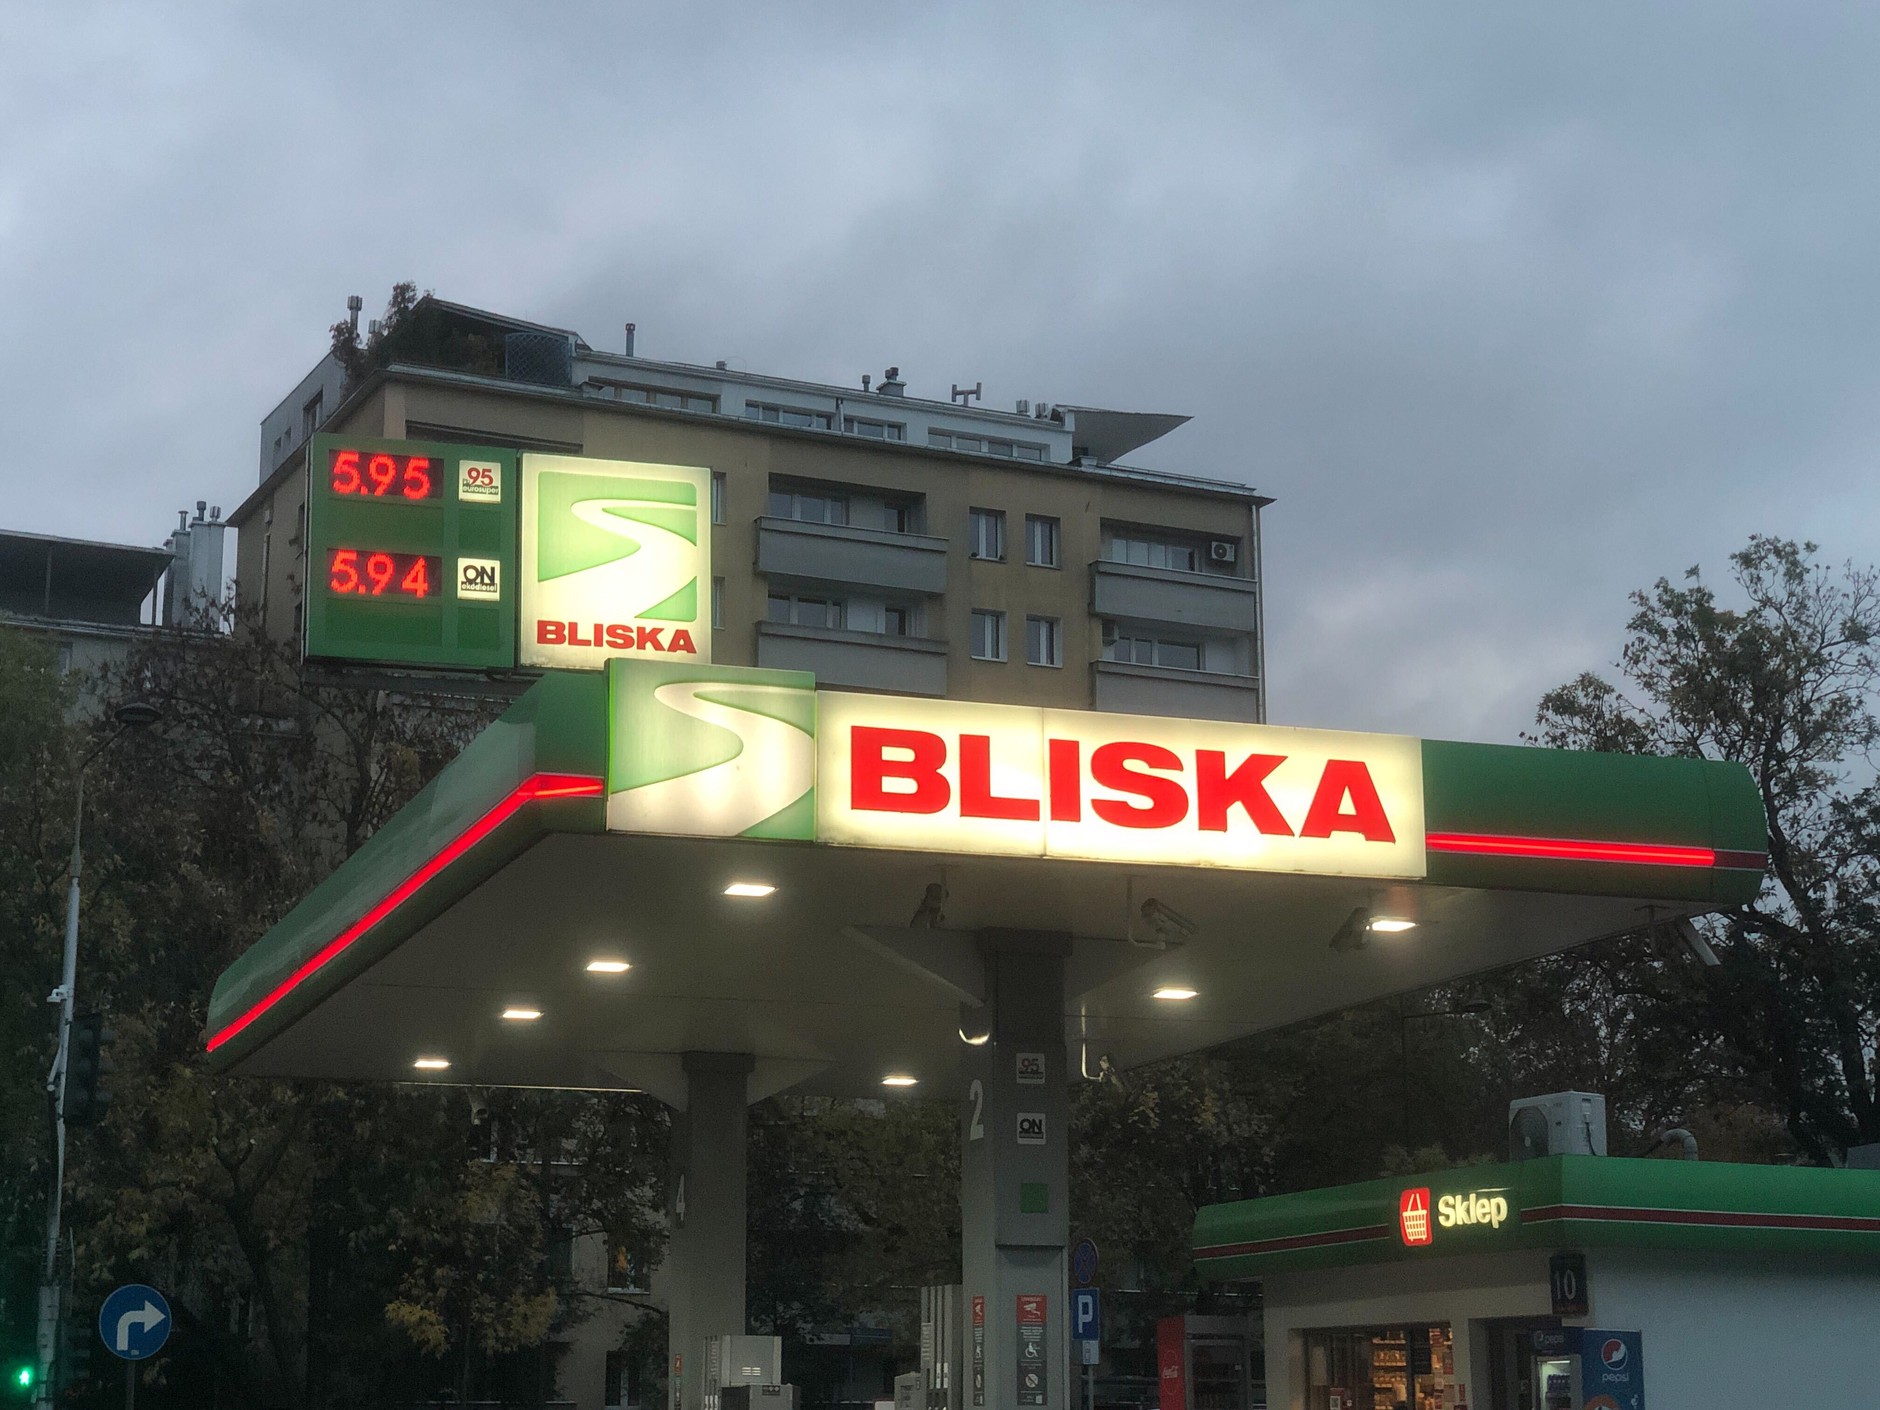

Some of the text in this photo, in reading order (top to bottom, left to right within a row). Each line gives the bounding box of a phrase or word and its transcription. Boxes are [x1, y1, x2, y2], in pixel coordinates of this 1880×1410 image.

[332, 450, 431, 500] 5.95
[462, 485, 499, 495] eurosuper
[467, 466, 494, 487] 95
[330, 549, 429, 598] 5.94
[463, 564, 496, 584] ON
[537, 620, 697, 653] BLISKA
[850, 726, 1395, 843] BLISKA
[1021, 1057, 1040, 1073] 95
[969, 1079, 985, 1141] 2
[1019, 1117, 1043, 1134] ON
[1438, 1193, 1508, 1229] Sklep
[1554, 1268, 1577, 1300] 10
[1077, 1294, 1094, 1334] P
[1601, 1372, 1630, 1384] pepsi
